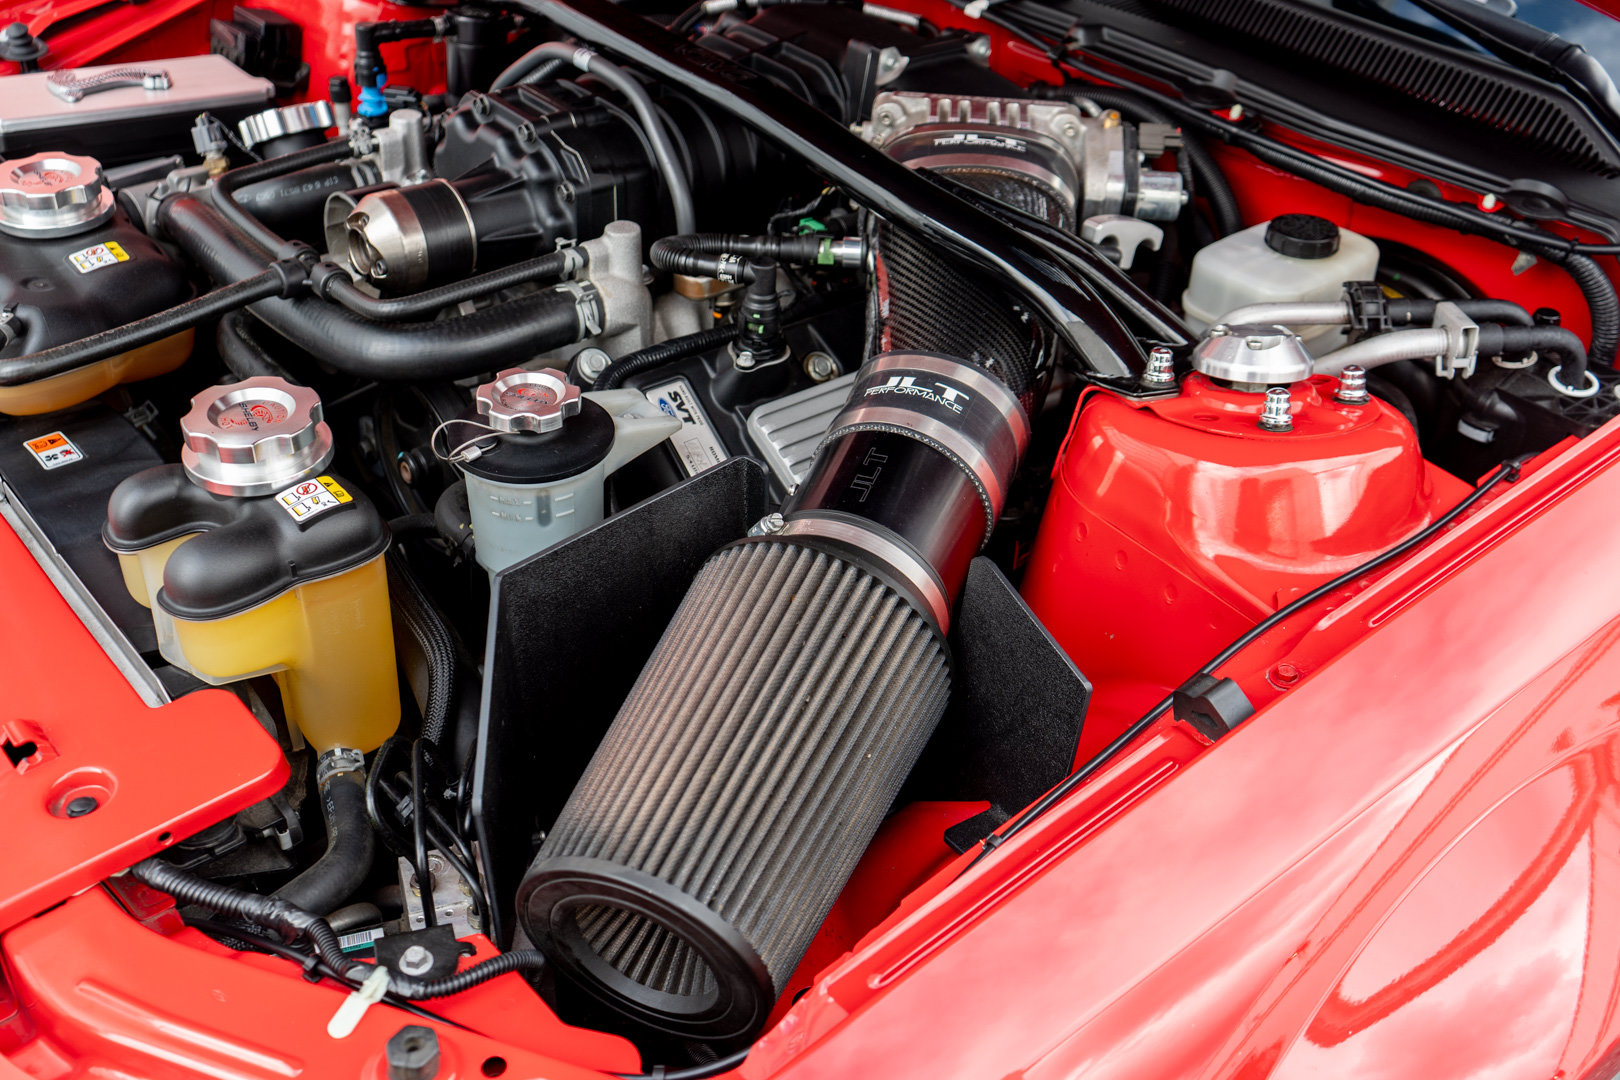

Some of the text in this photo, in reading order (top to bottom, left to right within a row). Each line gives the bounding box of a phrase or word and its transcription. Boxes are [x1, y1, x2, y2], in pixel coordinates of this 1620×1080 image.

[864, 386, 964, 414] PERFORMANCE
[867, 376, 970, 402] JLT
[239, 402, 259, 432] SHELBY
[667, 390, 697, 425] SVT
[850, 447, 889, 502] JLT
